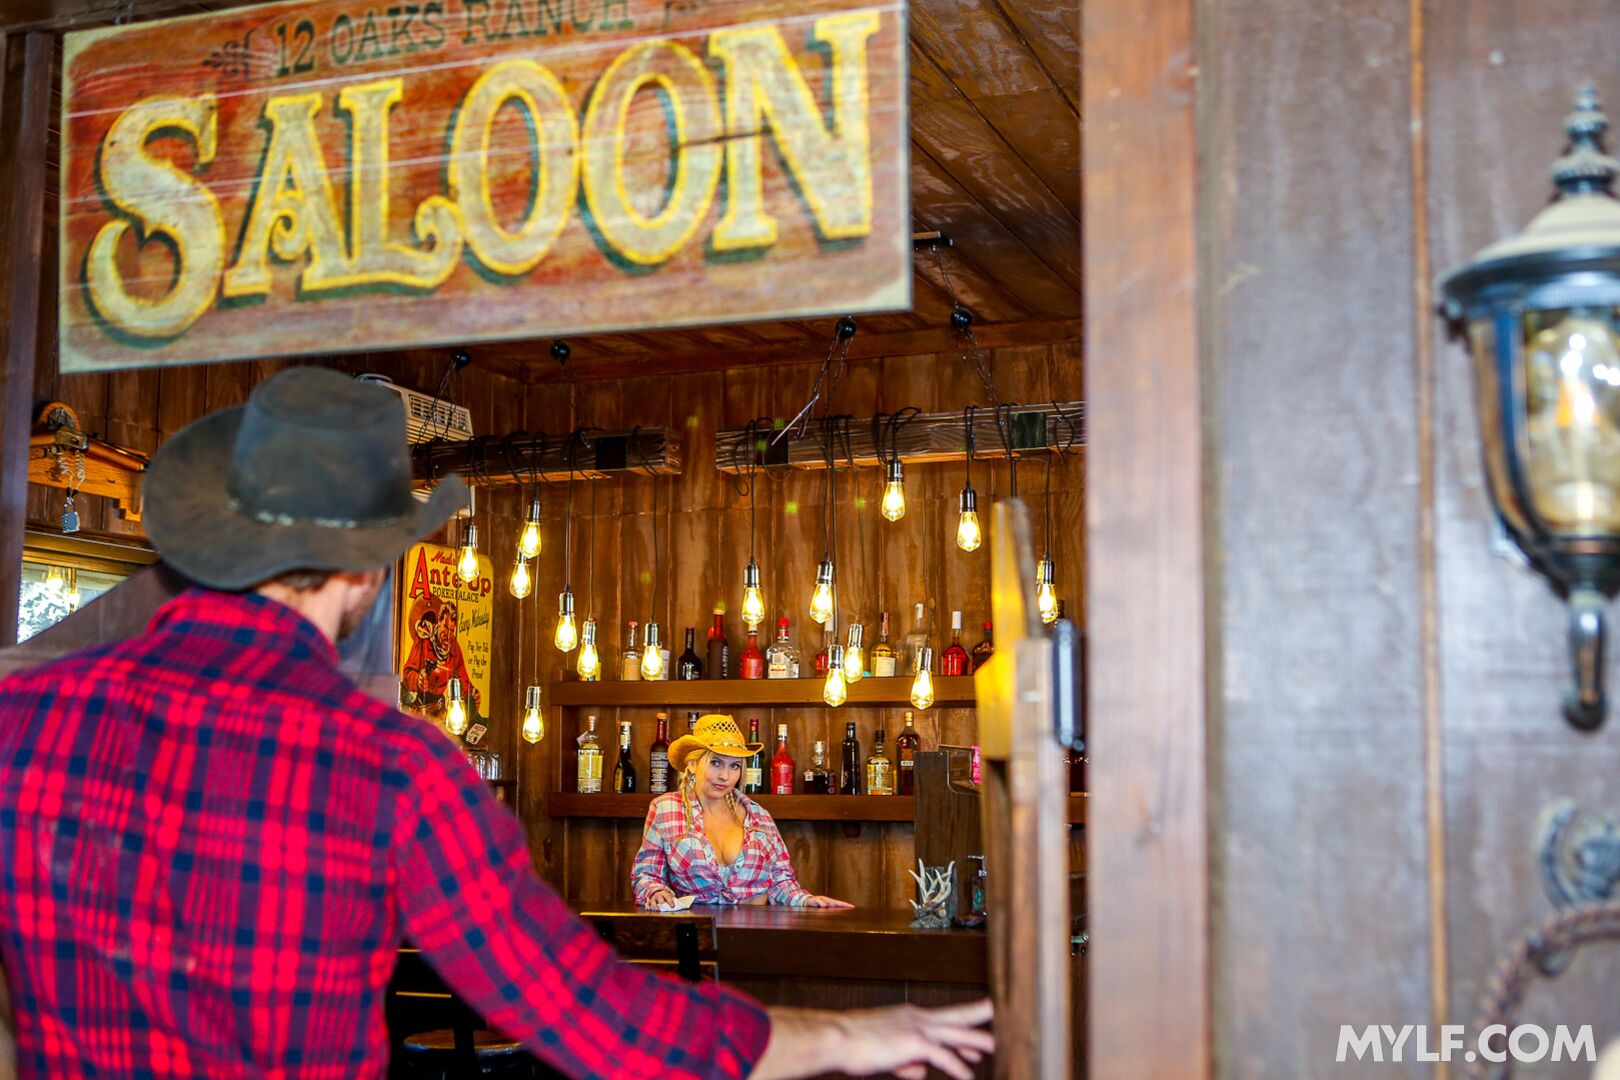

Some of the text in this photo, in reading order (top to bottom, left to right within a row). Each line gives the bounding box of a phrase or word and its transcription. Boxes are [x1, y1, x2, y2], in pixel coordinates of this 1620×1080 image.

[274, 0, 634, 78] 12 OAKS RANCH
[86, 10, 880, 341] SALOON
[409, 547, 462, 601] Ante
[432, 587, 455, 600] POKER
